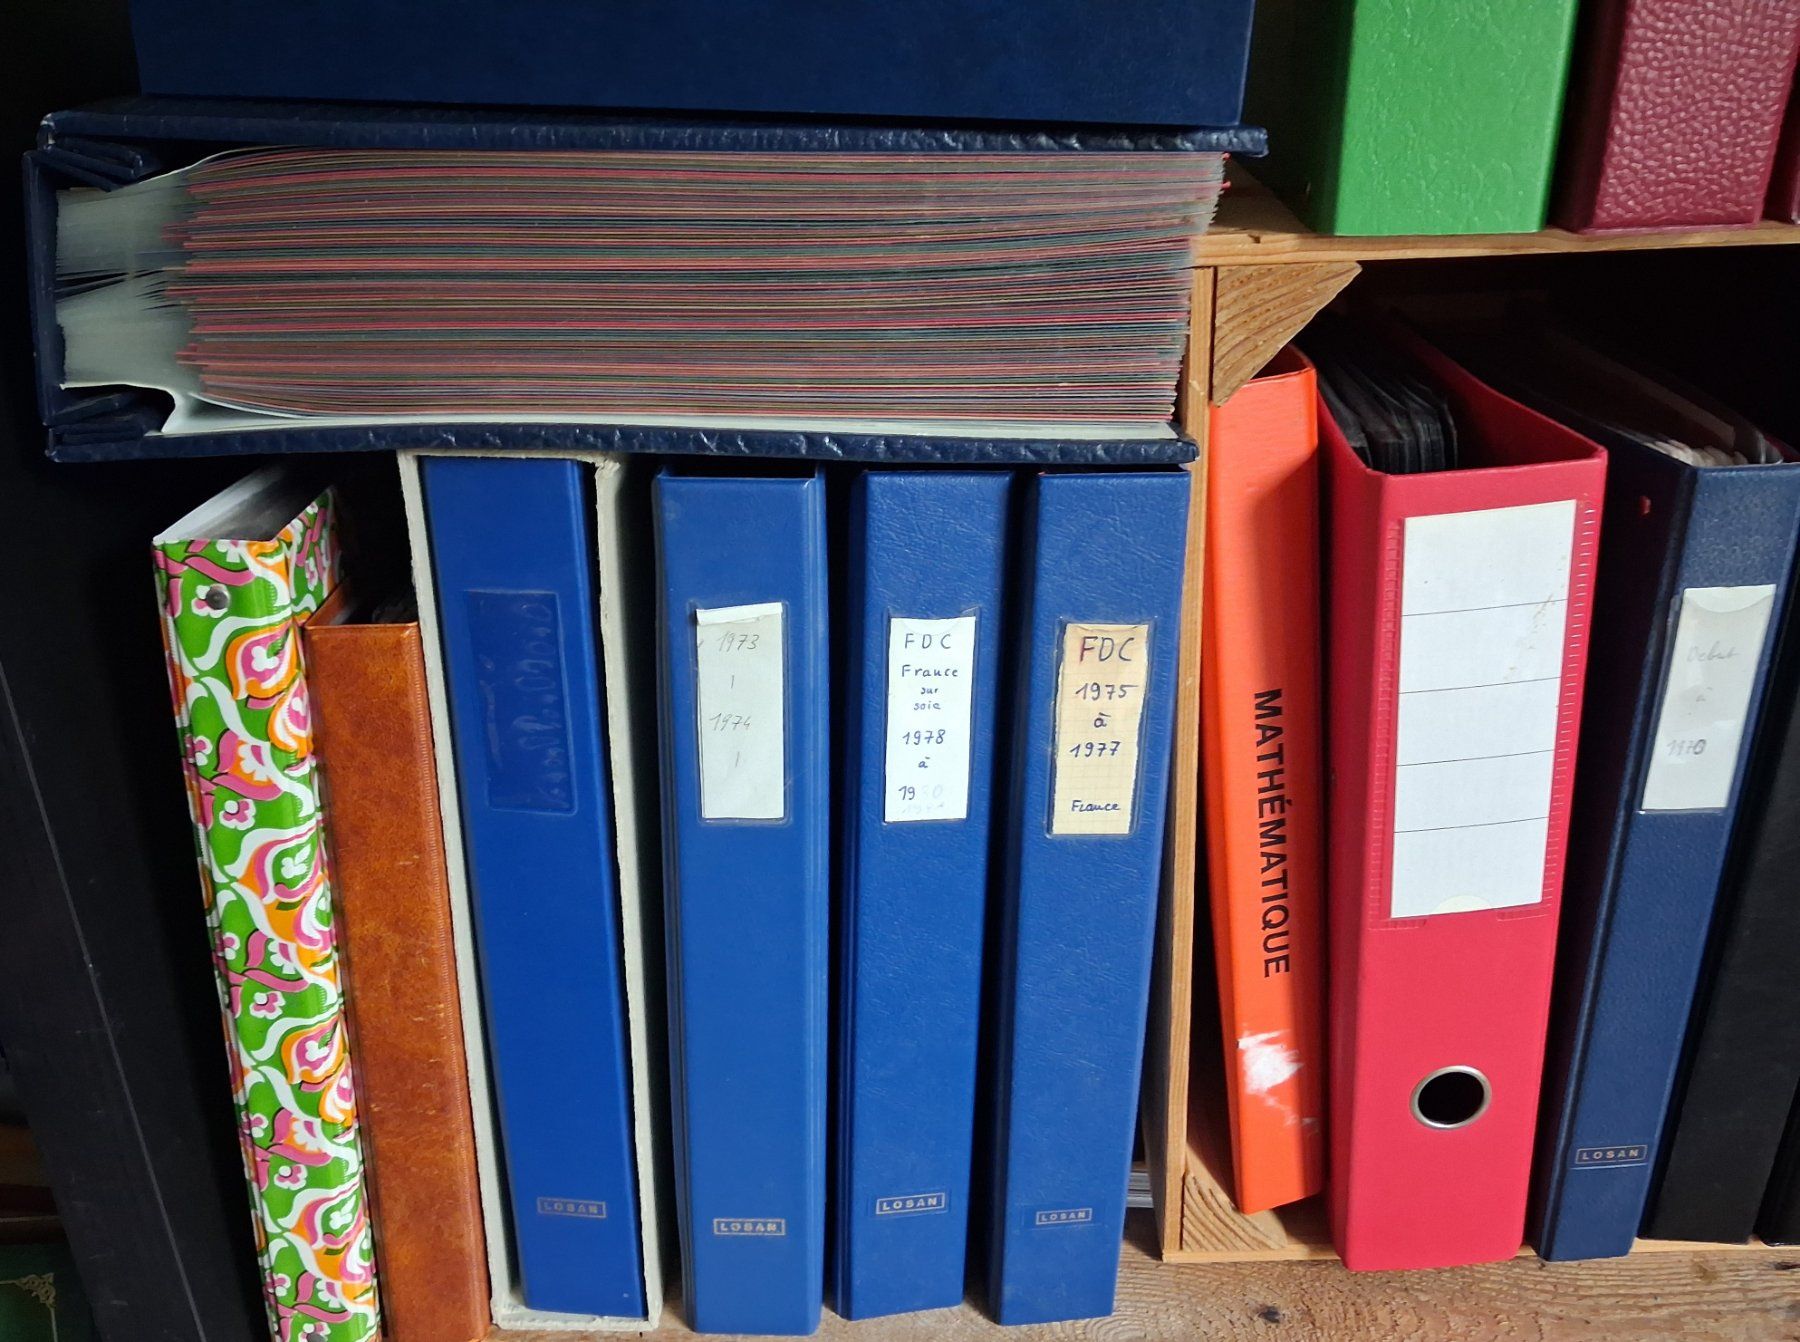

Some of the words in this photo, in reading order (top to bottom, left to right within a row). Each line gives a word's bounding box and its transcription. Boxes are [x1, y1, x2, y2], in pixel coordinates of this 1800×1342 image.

[717, 630, 760, 652] 1973
[1079, 635, 1135, 662] FDC
[901, 664, 958, 677] France
[920, 687, 939, 695] sur
[1075, 682, 1138, 700] 1975
[913, 700, 941, 711] soie
[709, 713, 751, 731] 1974
[1093, 712, 1111, 728] à
[902, 729, 946, 746] 1978
[1069, 740, 1121, 758] 1977
[917, 756, 931, 769] à
[1071, 799, 1120, 812] France
[1254, 688, 1292, 979] MATHÉMATIQUE
[1582, 1148, 1640, 1160] LOSAN
[543, 1202, 599, 1214] LOSAN
[882, 1196, 938, 1211] LOSAN
[1041, 1211, 1087, 1222] LOSAN
[720, 1221, 777, 1232] LOSAN
